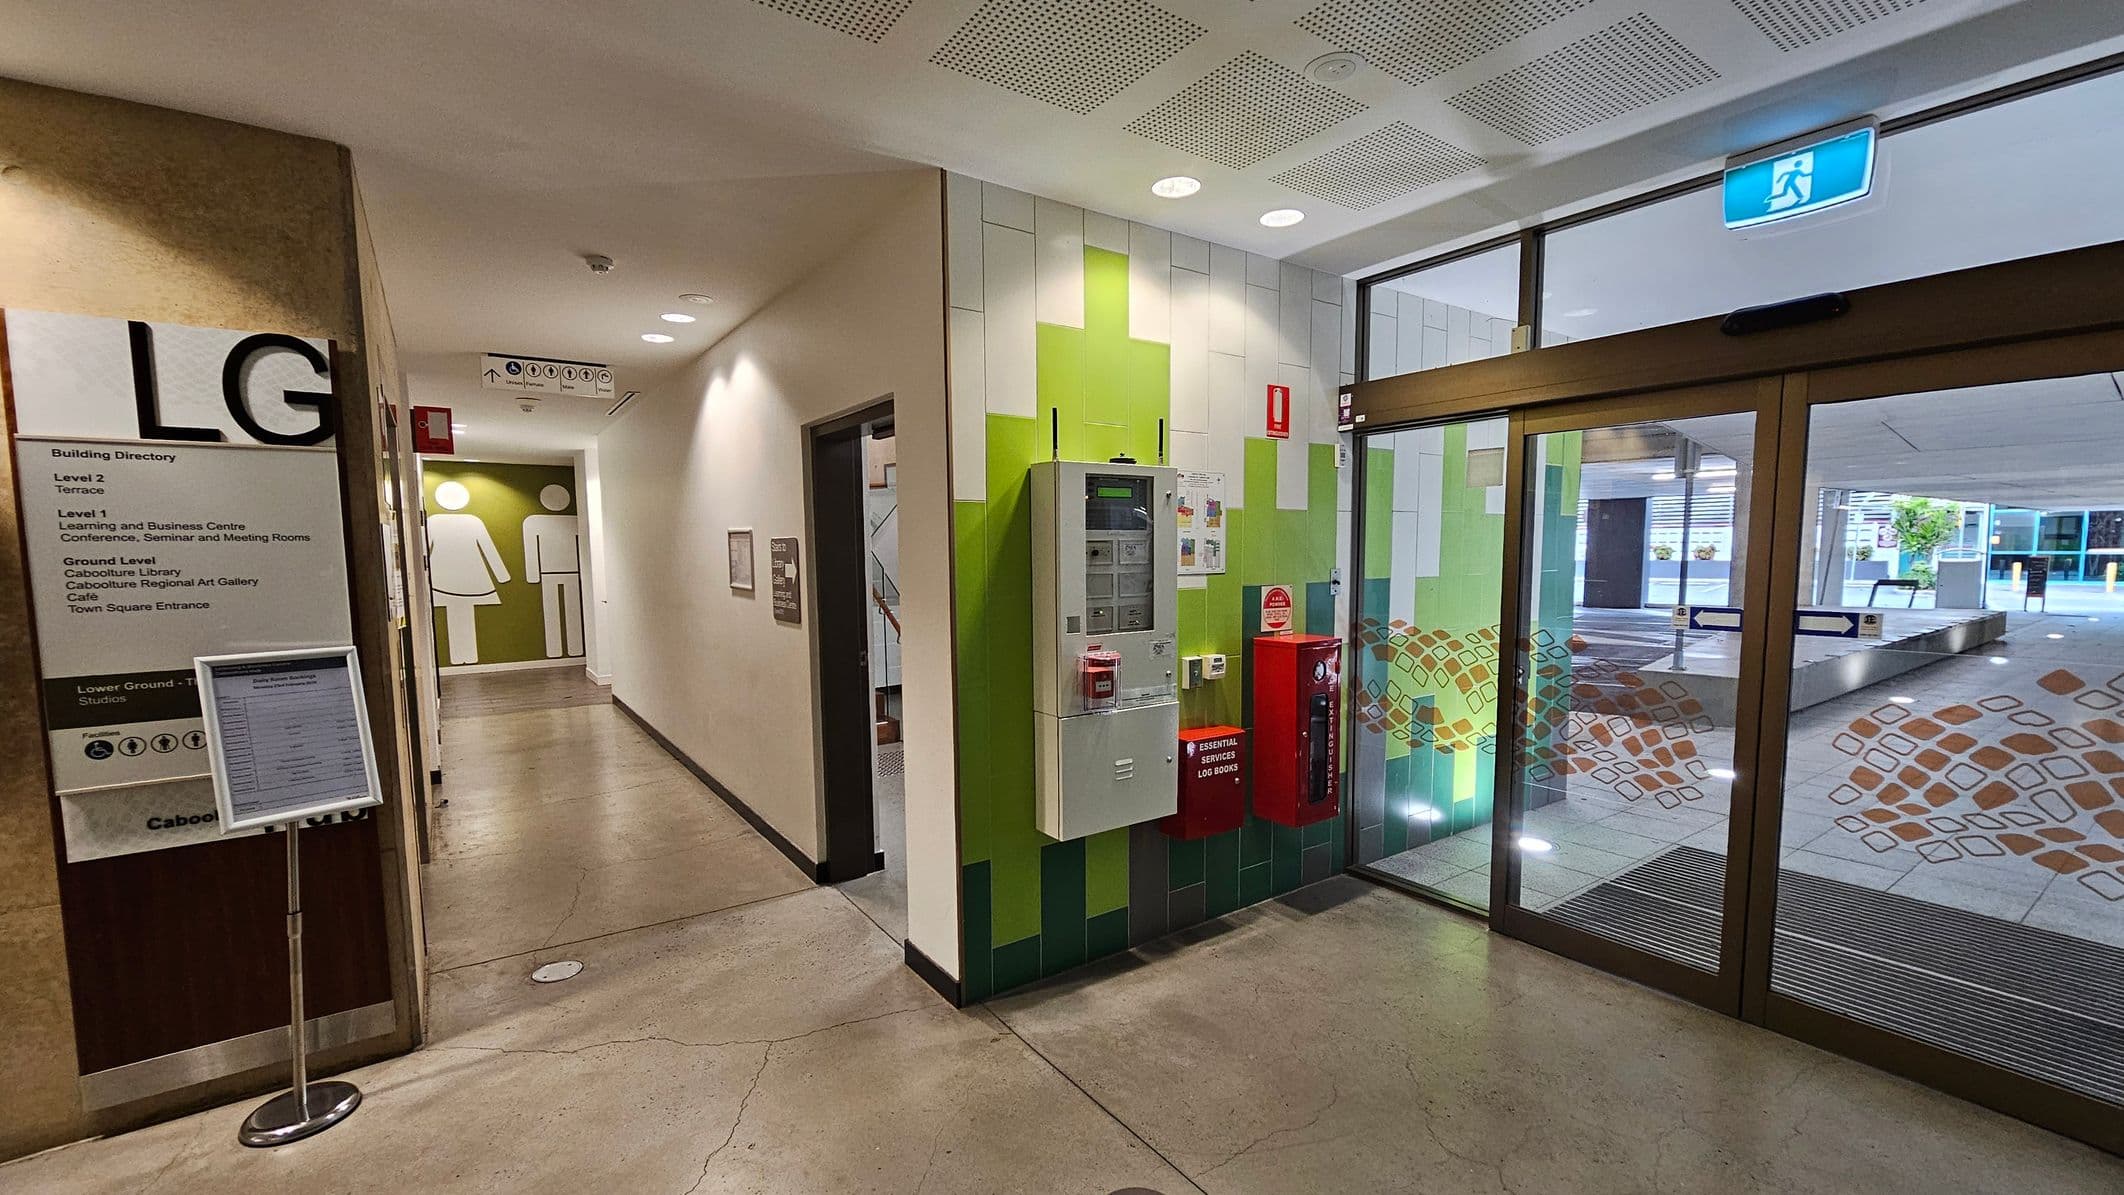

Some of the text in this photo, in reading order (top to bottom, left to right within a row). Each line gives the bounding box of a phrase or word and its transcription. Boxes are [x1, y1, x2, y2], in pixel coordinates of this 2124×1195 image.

[128, 320, 337, 446] LG
[51, 448, 176, 463] Building Directory
[54, 473, 105, 483] Level 2
[55, 484, 105, 494] Terrace
[58, 509, 106, 518] Level 1
[59, 521, 246, 532] Learning and Business Centre
[143, 533, 195, 542] Seminar
[198, 533, 220, 542] and
[224, 533, 269, 543] Meeting
[272, 533, 311, 542] Rooms
[63, 556, 156, 566] Ground Level
[64, 568, 181, 578] Caboolture Library
[65, 577, 259, 590] Caboolture Regional Art Gallery
[67, 602, 210, 614] Town Square Entrance
[77, 683, 121, 694] Lower
[124, 680, 174, 691] Ground
[79, 695, 127, 706] Studios
[1199, 738, 1238, 751] ESSENTIAL
[1327, 701, 1335, 794] EXTINGUISHER
[1201, 751, 1236, 764] SERVICES
[1198, 763, 1239, 778] LOG BOOKS
[146, 809, 219, 830] Cabool
